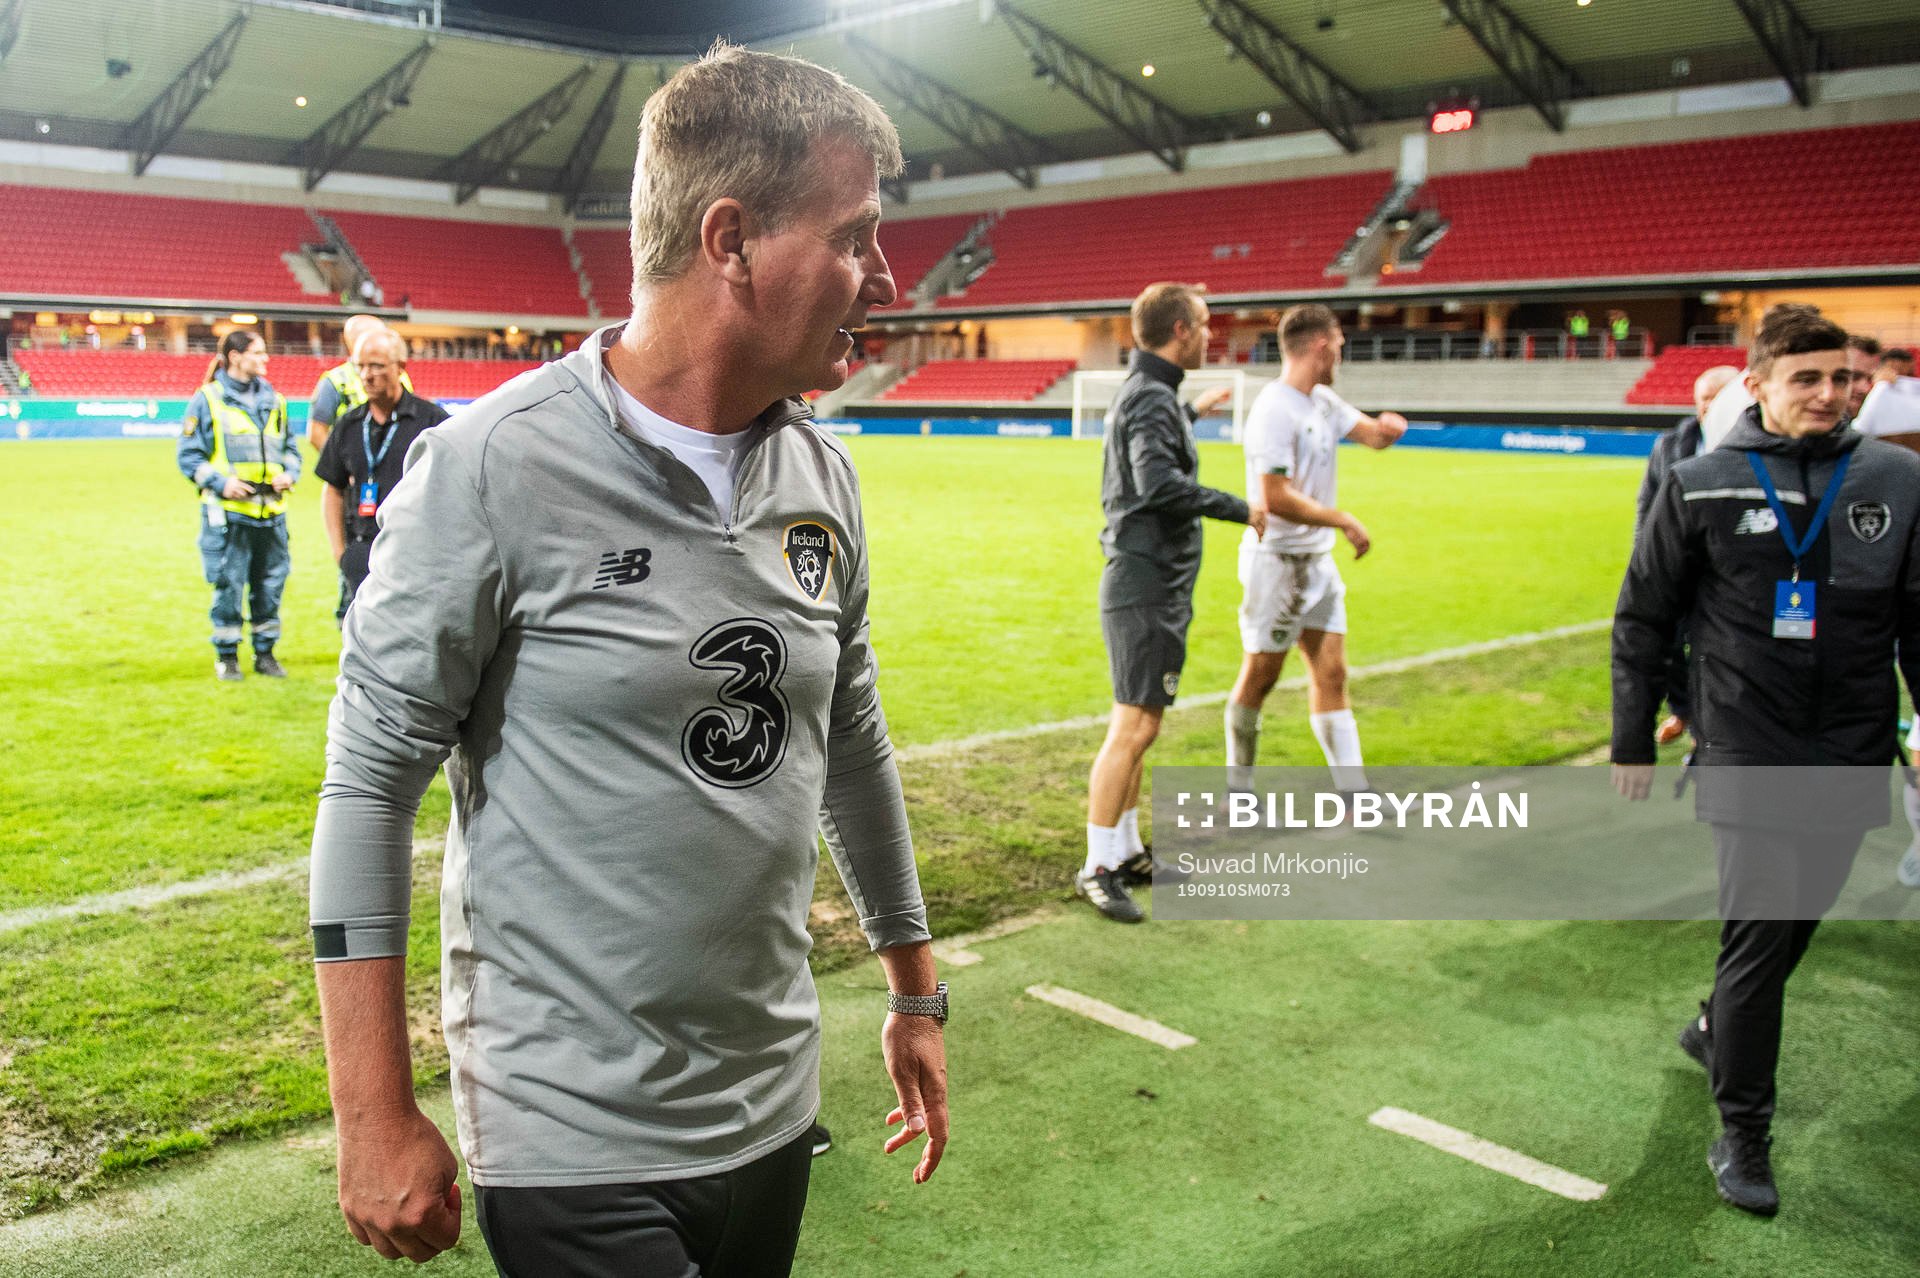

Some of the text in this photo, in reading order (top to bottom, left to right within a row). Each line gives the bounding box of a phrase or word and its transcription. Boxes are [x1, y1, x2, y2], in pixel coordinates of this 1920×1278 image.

[792, 530, 825, 548] Ireland
[592, 547, 652, 590] NB
[681, 617, 791, 789] 3
